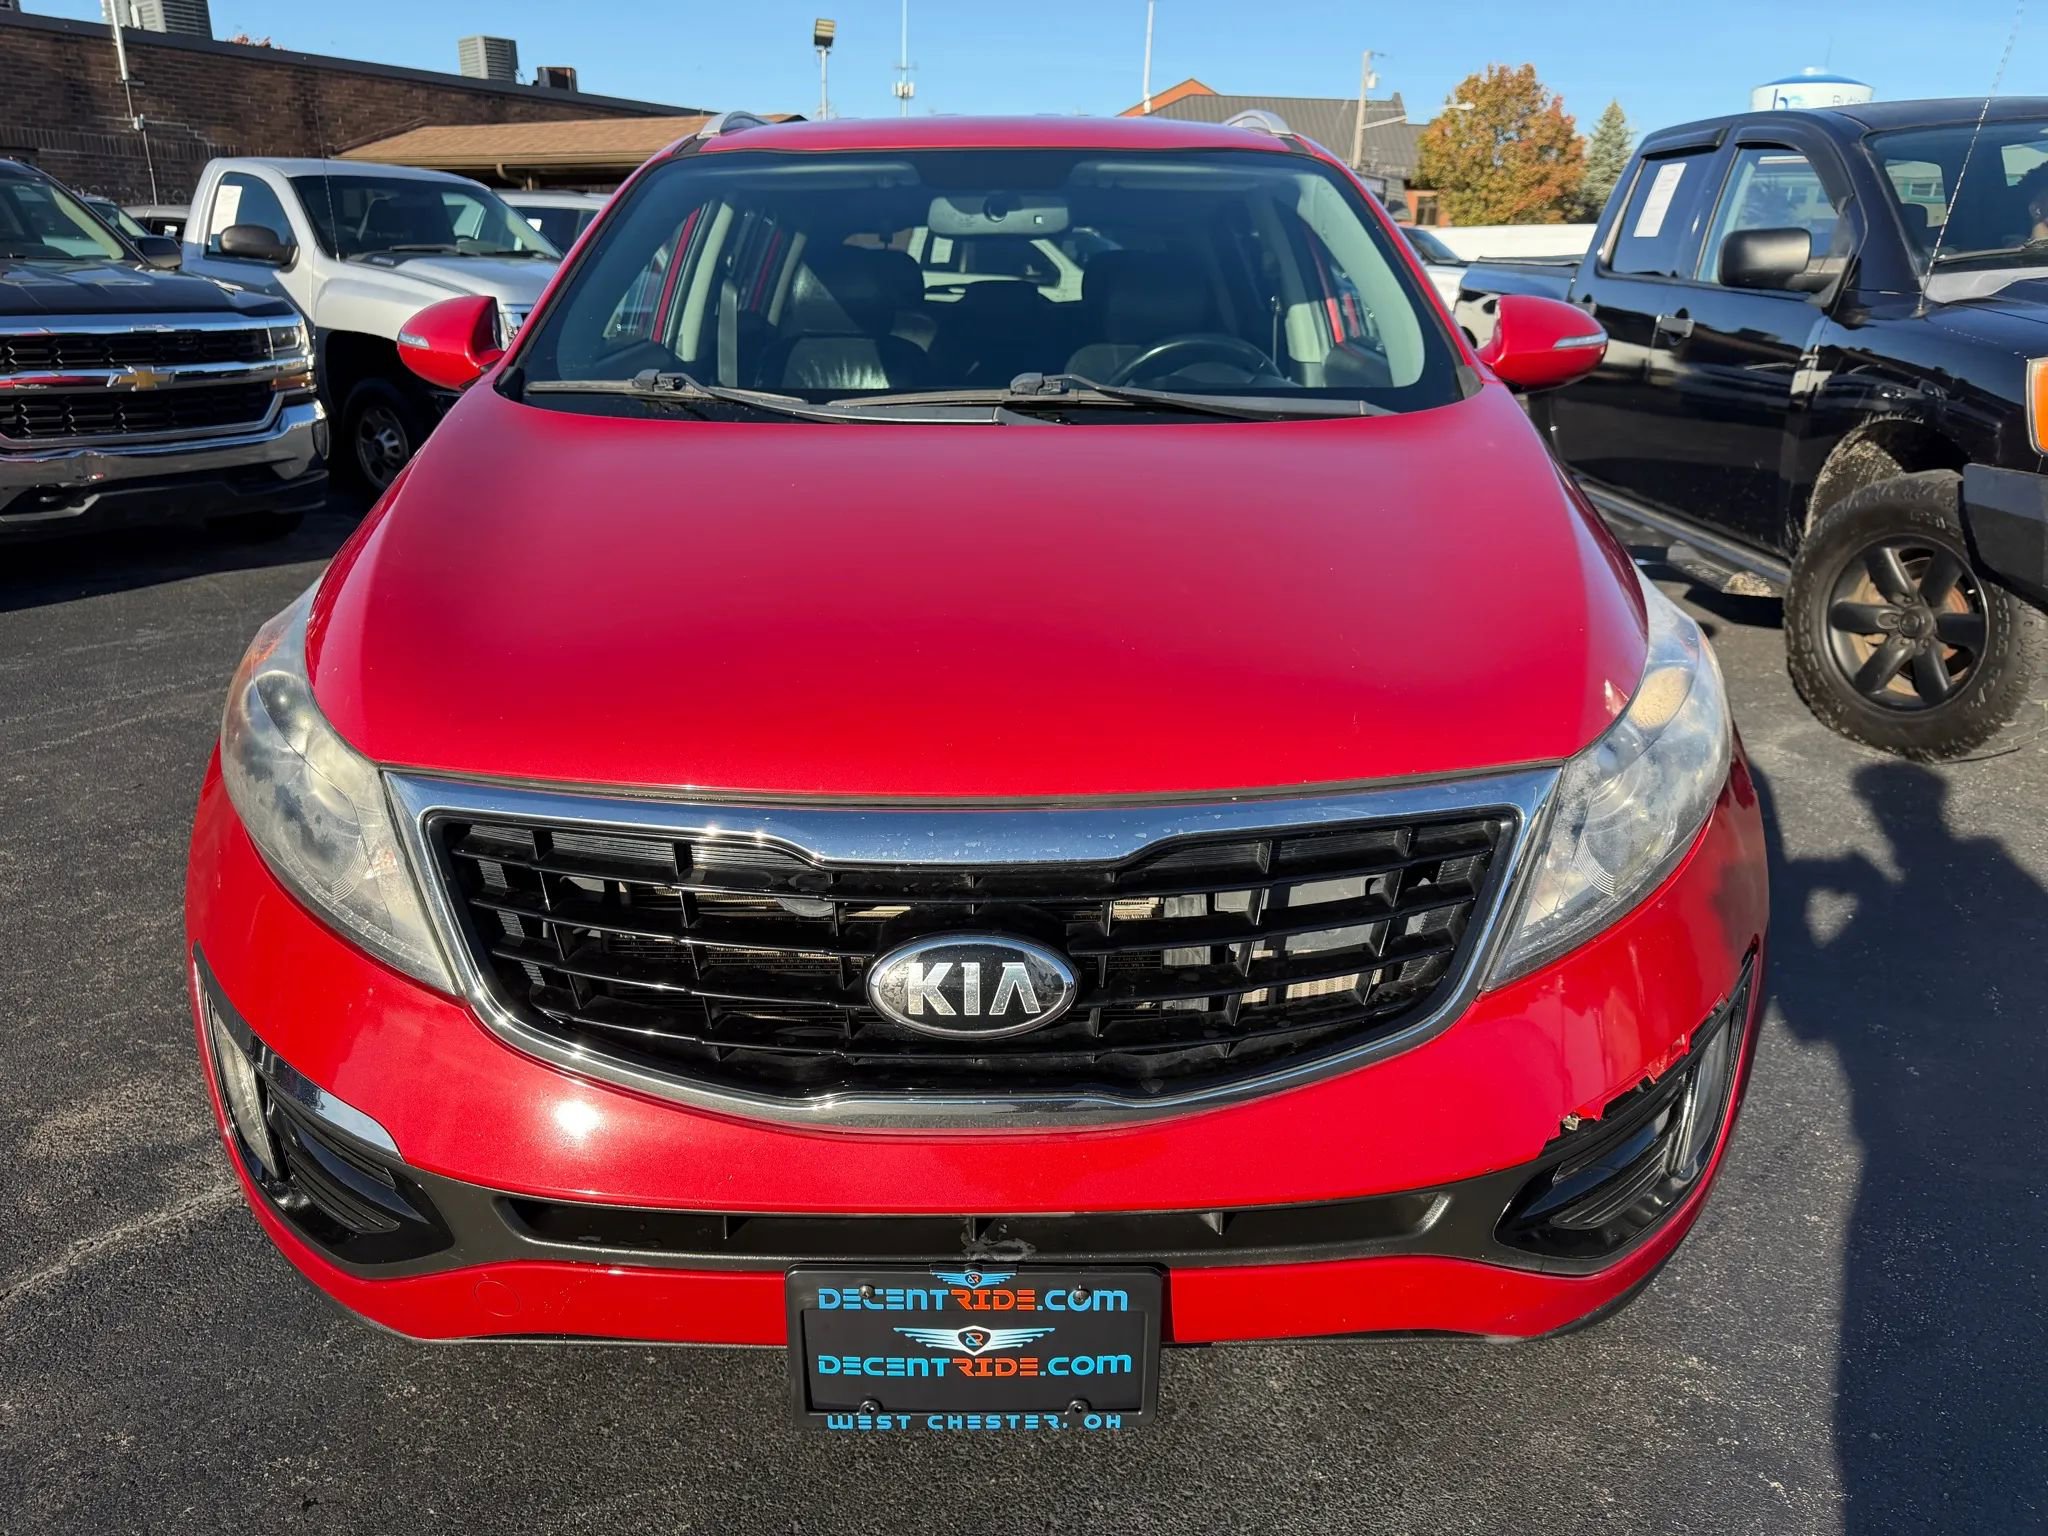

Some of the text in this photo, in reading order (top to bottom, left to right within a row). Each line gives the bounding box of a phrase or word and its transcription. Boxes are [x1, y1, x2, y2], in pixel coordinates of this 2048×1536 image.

[906, 962, 1041, 1015] KIA
[827, 1415, 1121, 1430] WEST CHESTER, OH
